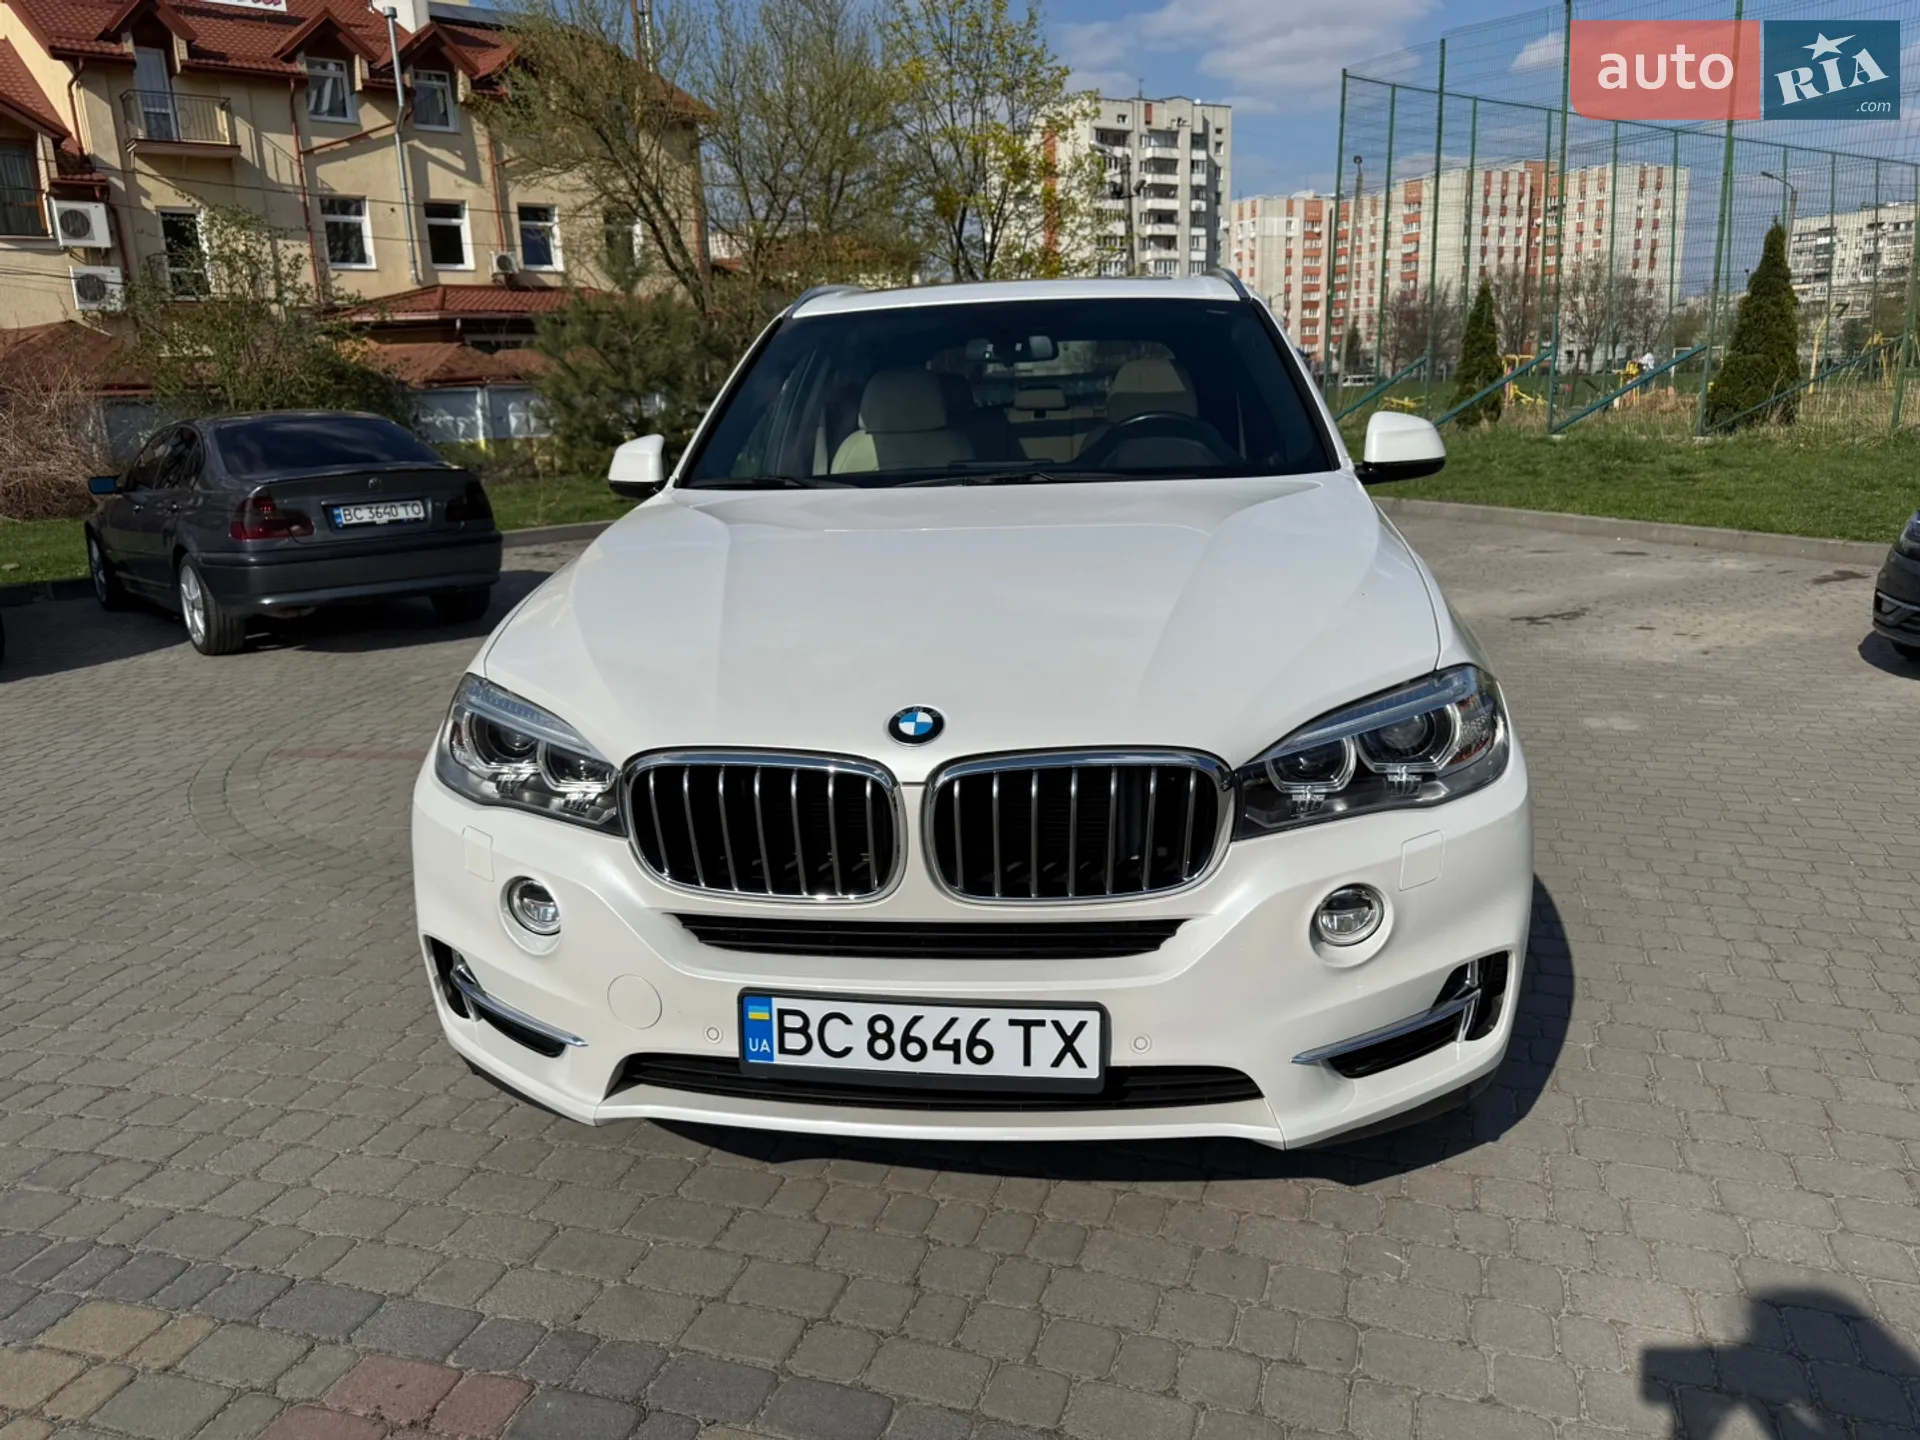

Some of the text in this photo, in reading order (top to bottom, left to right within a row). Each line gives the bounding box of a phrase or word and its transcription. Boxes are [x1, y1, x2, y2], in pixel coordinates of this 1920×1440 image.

[342, 502, 422, 522] BC 3640 TO
[748, 1038, 771, 1053] UA
[776, 1008, 1089, 1069] BC 8646 TX
